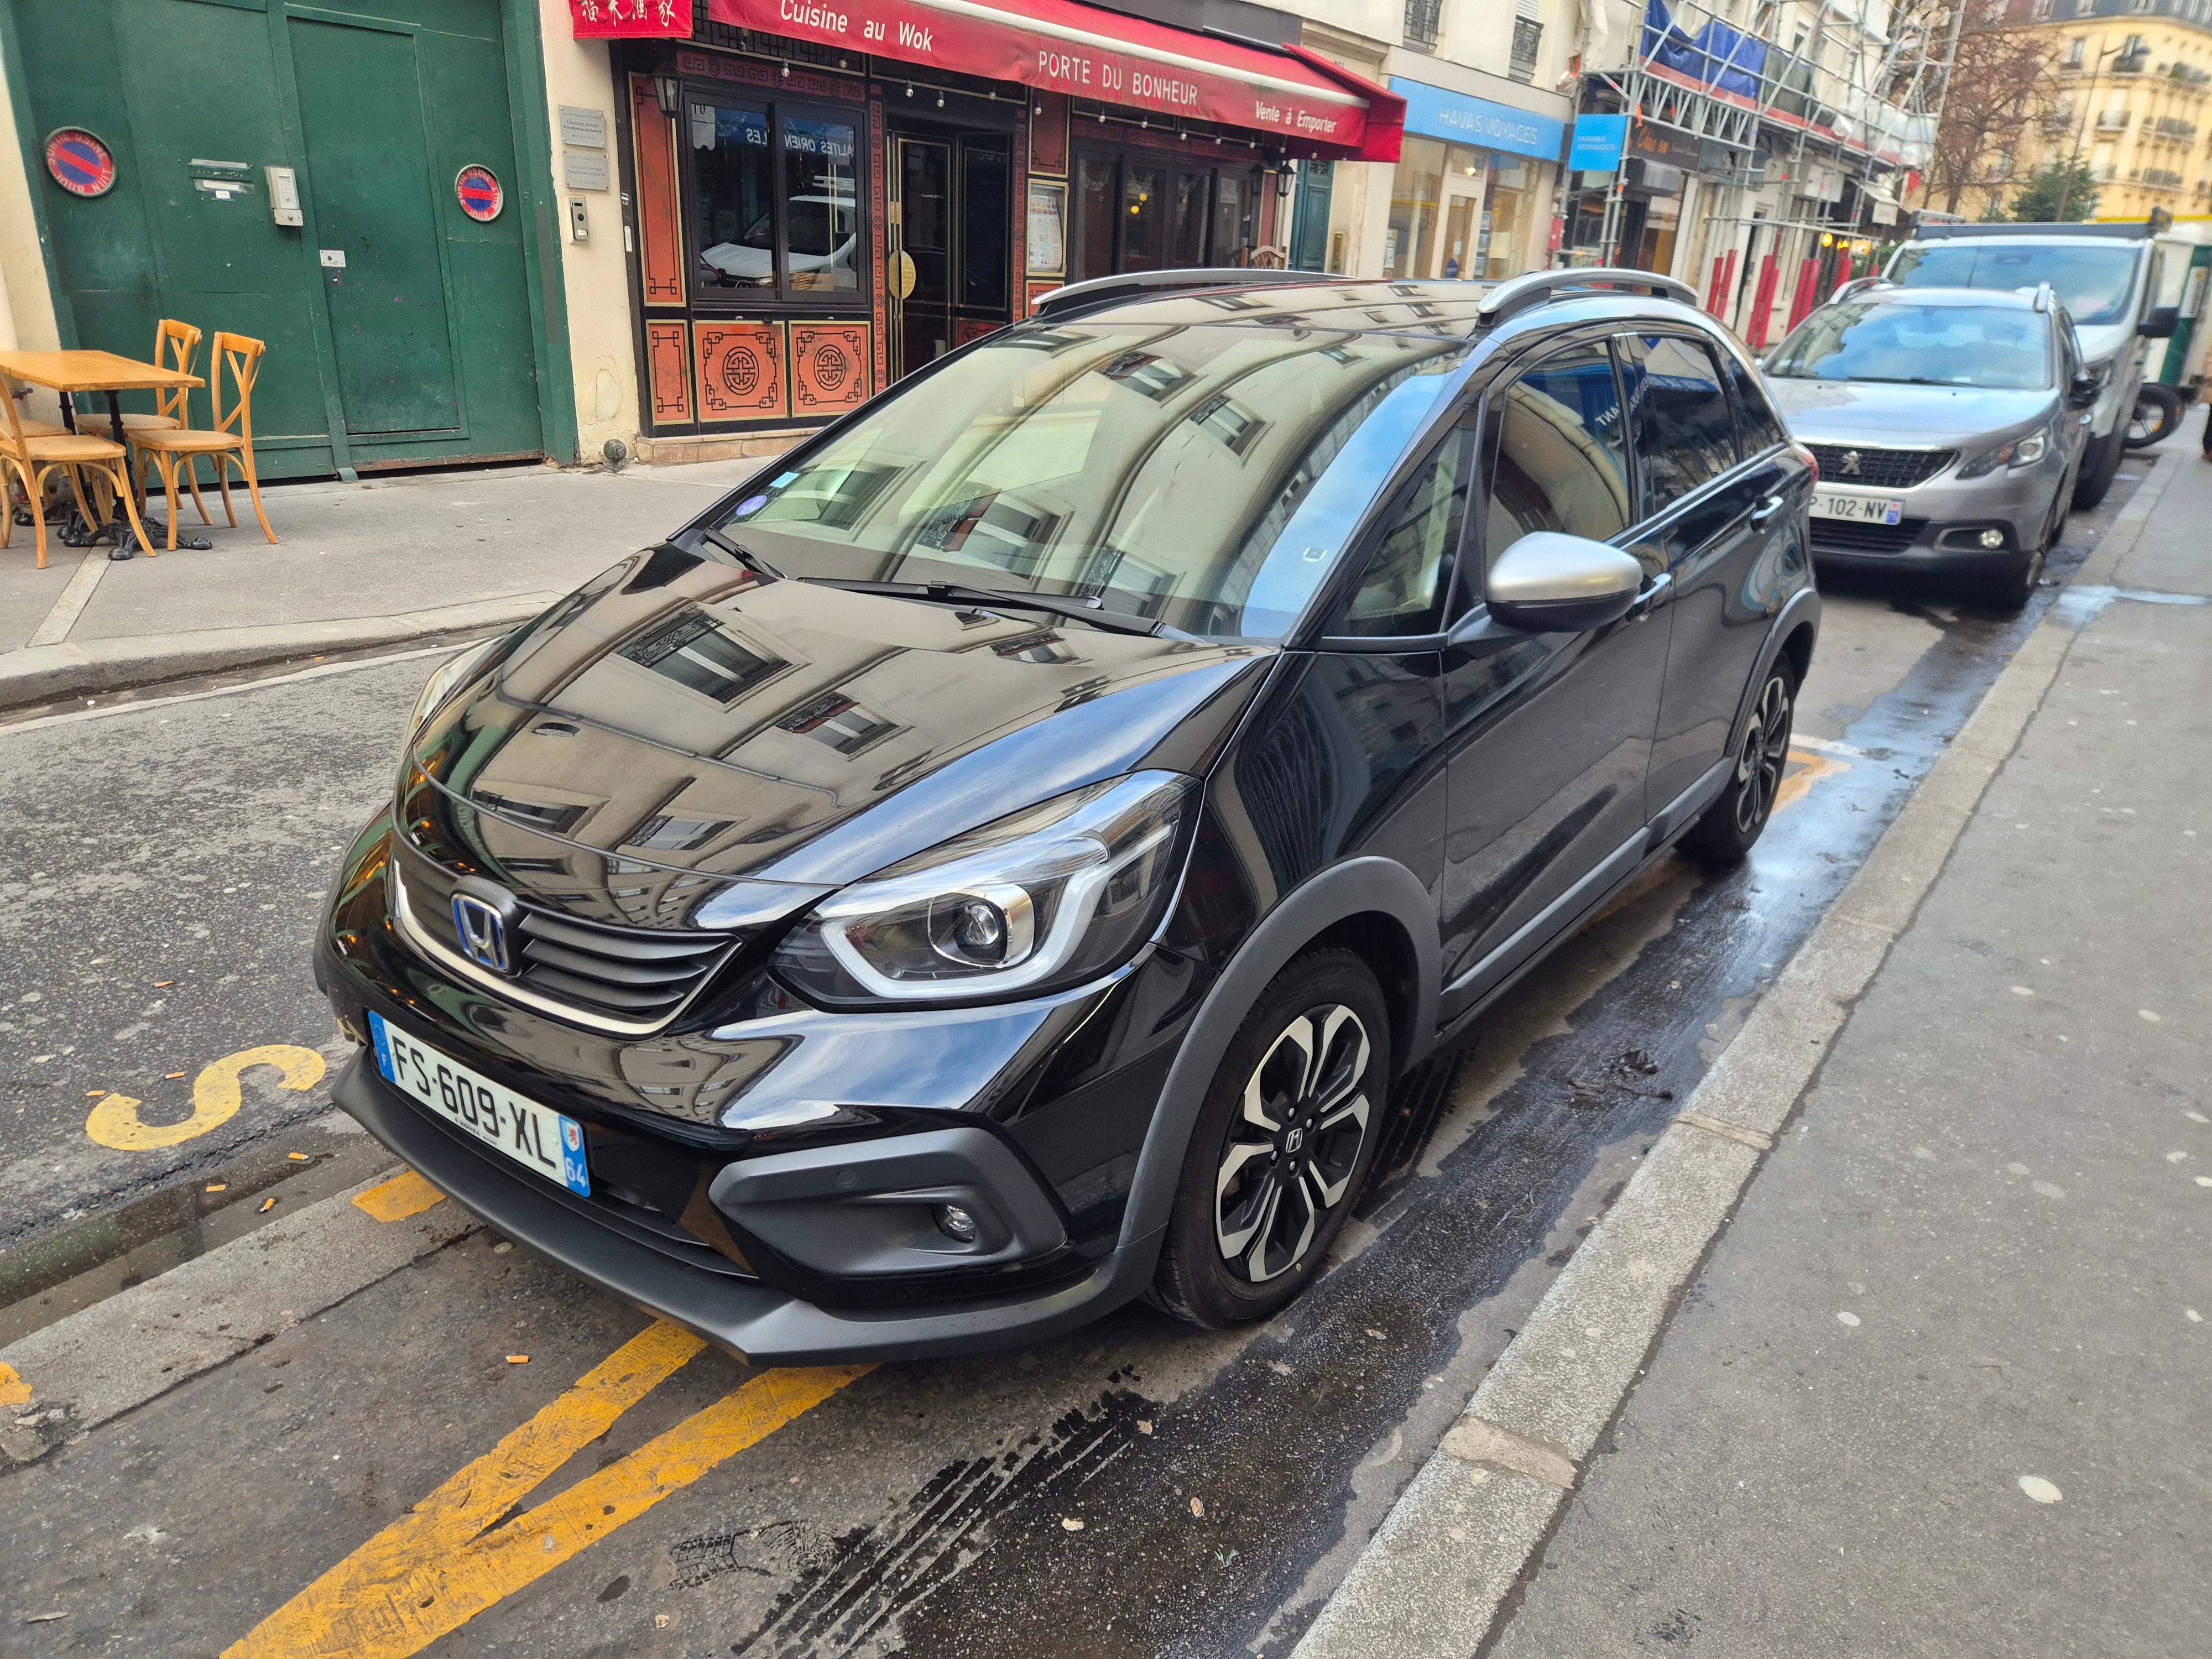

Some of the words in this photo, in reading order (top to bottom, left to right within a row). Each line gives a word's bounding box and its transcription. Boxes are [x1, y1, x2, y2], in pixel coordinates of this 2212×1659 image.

[781, 0, 848, 33] Cuisine
[864, 19, 885, 41] au
[899, 21, 933, 51] Wok
[1039, 50, 1091, 84] PORTE
[1103, 64, 1122, 90] DU
[1133, 72, 1198, 106] BONHEUR
[1256, 101, 1280, 122] Vente
[1285, 107, 1292, 124] à
[1297, 110, 1337, 133] Emporter
[1439, 106, 1483, 133] HAVAS
[1486, 117, 1539, 145] VOYAGES
[56, 173, 85, 192] JOUR
[91, 168, 112, 192] NUIT
[469, 210, 489, 219] JOUR
[381, 1053, 387, 1067] F
[392, 1035, 556, 1169] FS-609-XL
[460, 1121, 481, 1137] HONDA
[565, 1157, 586, 1188] 64
